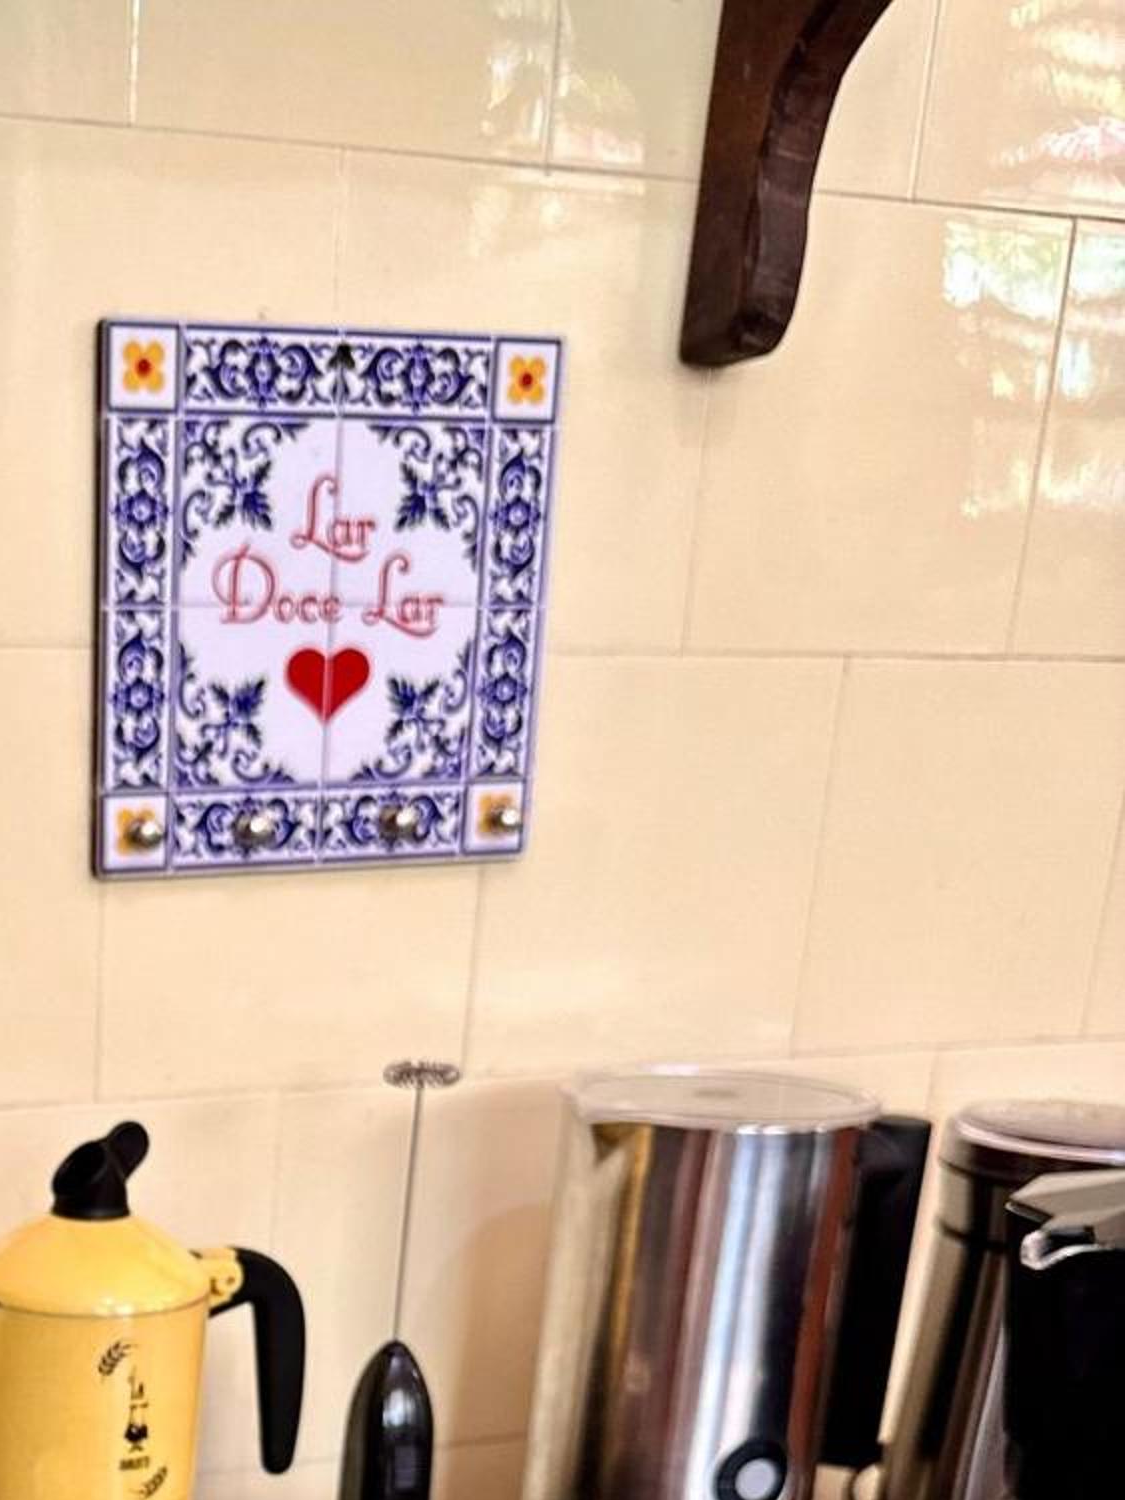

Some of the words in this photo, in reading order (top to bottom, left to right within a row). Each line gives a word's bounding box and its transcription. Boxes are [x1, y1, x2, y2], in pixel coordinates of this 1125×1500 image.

[290, 474, 377, 562] Lar
[212, 544, 341, 625] Doce
[362, 554, 444, 638] Lar
